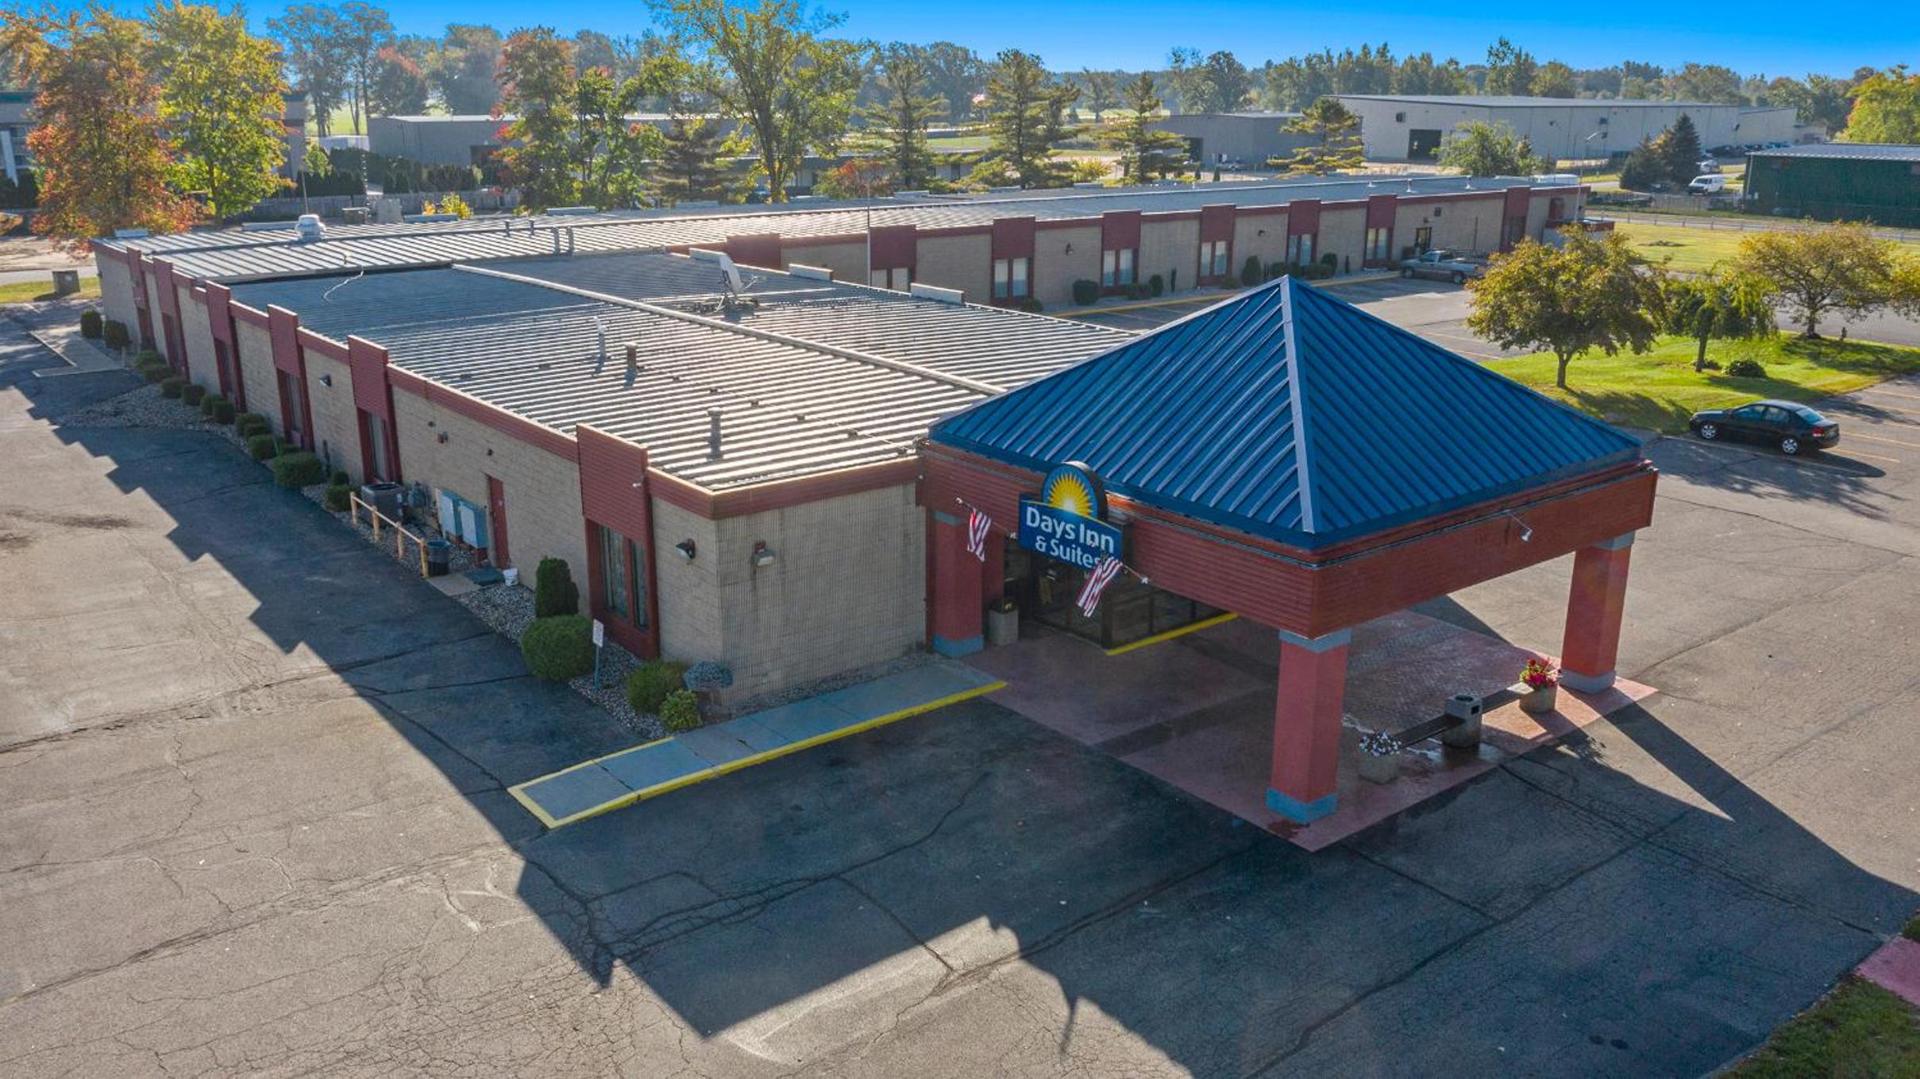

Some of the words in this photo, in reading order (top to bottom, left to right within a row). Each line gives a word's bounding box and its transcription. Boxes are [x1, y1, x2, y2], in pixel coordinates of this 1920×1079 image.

[1026, 506, 1076, 539] Days
[1079, 523, 1115, 554] Inn
[1035, 536, 1047, 553] &
